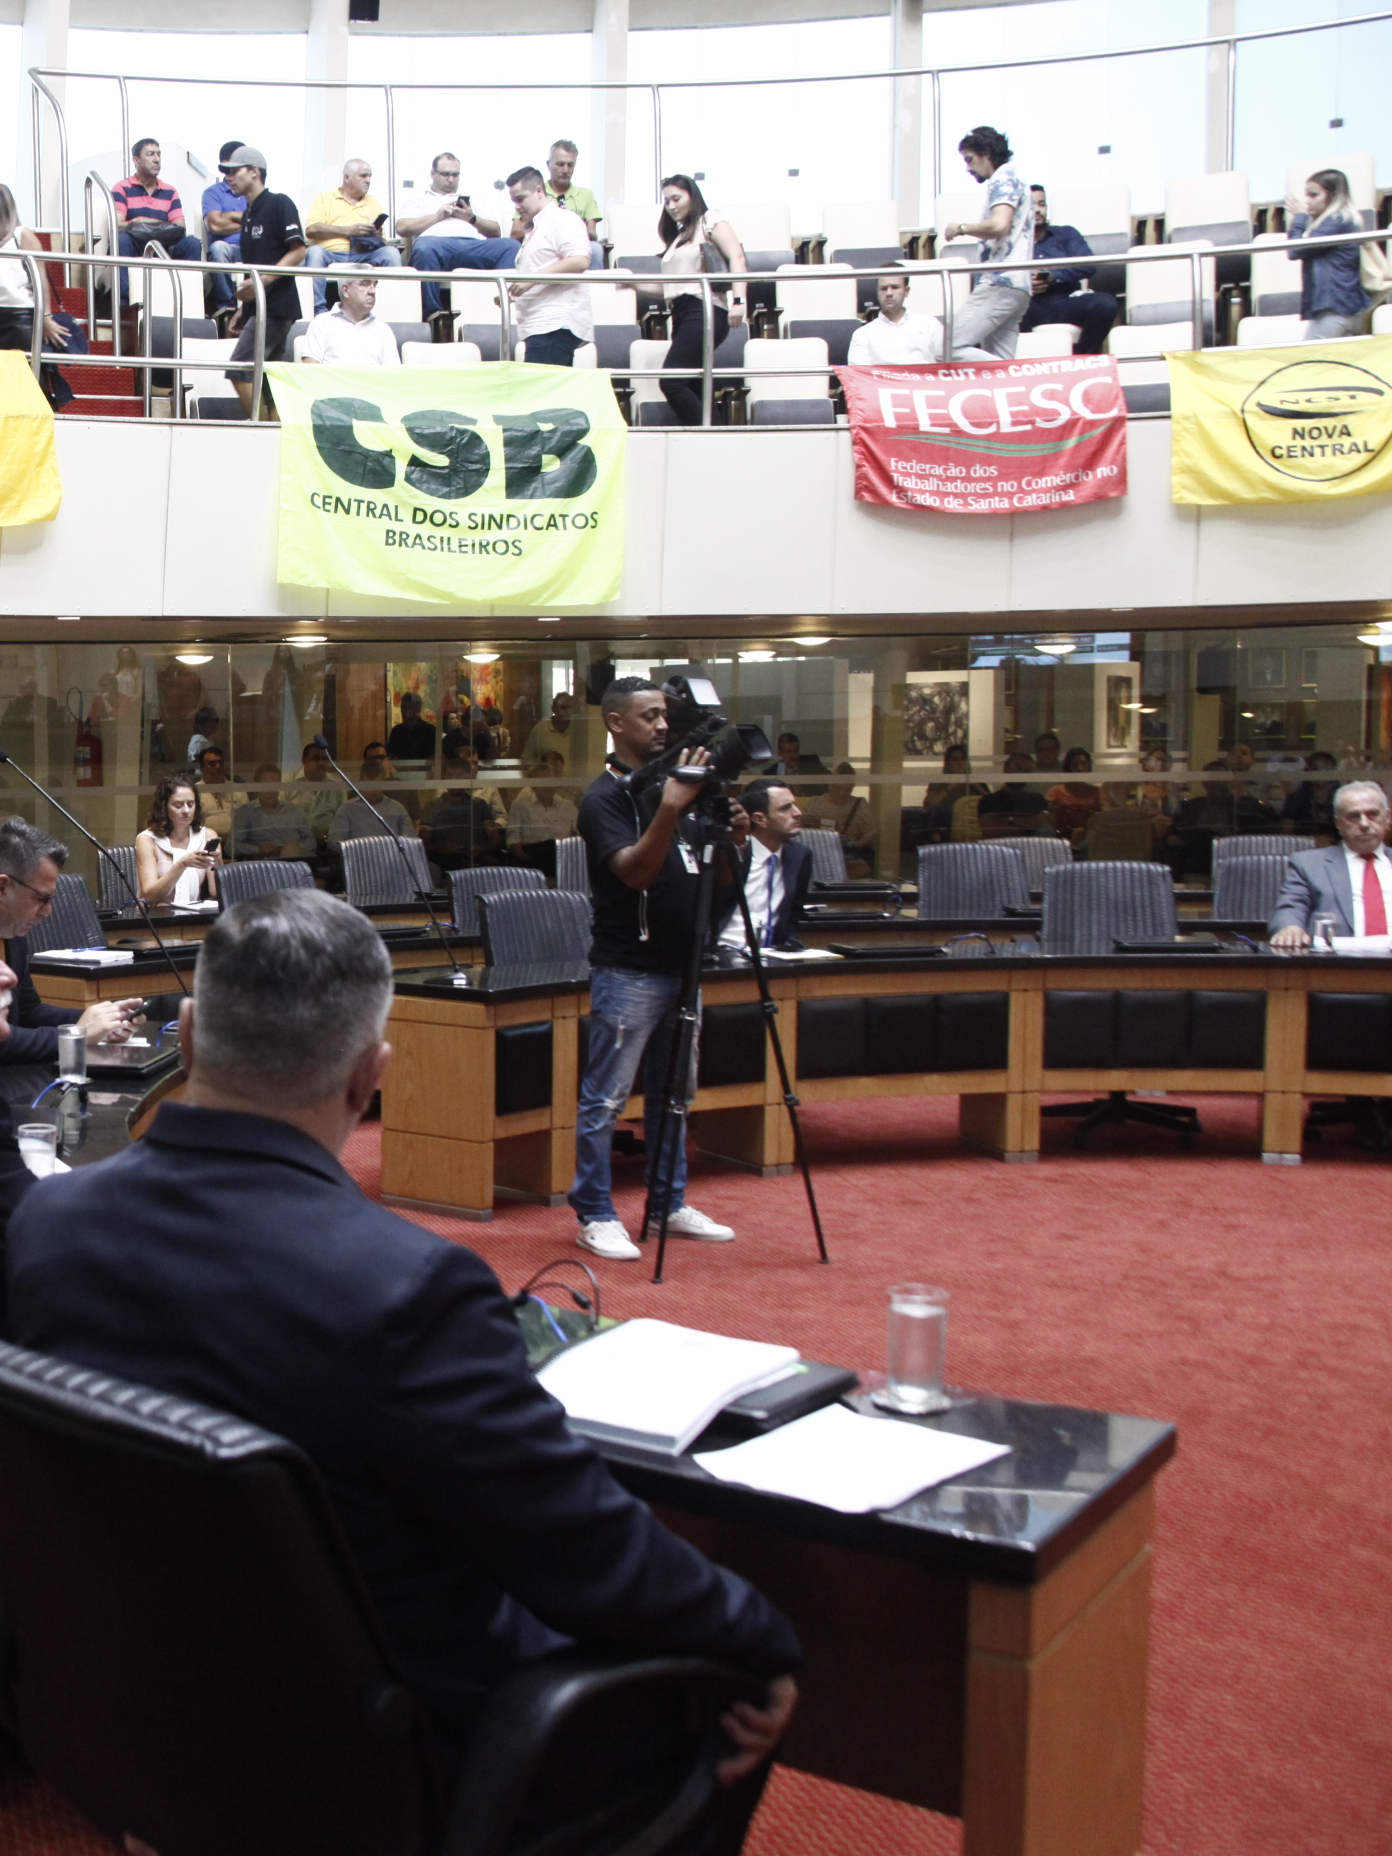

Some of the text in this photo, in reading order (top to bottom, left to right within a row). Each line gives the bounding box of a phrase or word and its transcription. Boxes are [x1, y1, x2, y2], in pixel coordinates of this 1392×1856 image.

[924, 372, 936, 382] a
[937, 367, 977, 382] CUT
[980, 369, 993, 380] e
[994, 368, 1007, 379] a
[1008, 354, 1112, 378] CONTRACS
[877, 376, 1119, 435] FECESC
[1278, 393, 1363, 406] NCST
[1290, 423, 1353, 441] NOVA
[310, 397, 597, 500] CSB
[1269, 439, 1376, 460] CENTRAL
[890, 457, 999, 480] Federação dos
[890, 464, 1118, 494] Trabalhadores no Comércio no
[309, 491, 599, 532] CENTRAL DOS SINDICATOS
[891, 488, 1076, 510] Estado de Santa Catarina
[384, 528, 523, 557] BRASILEIROS
